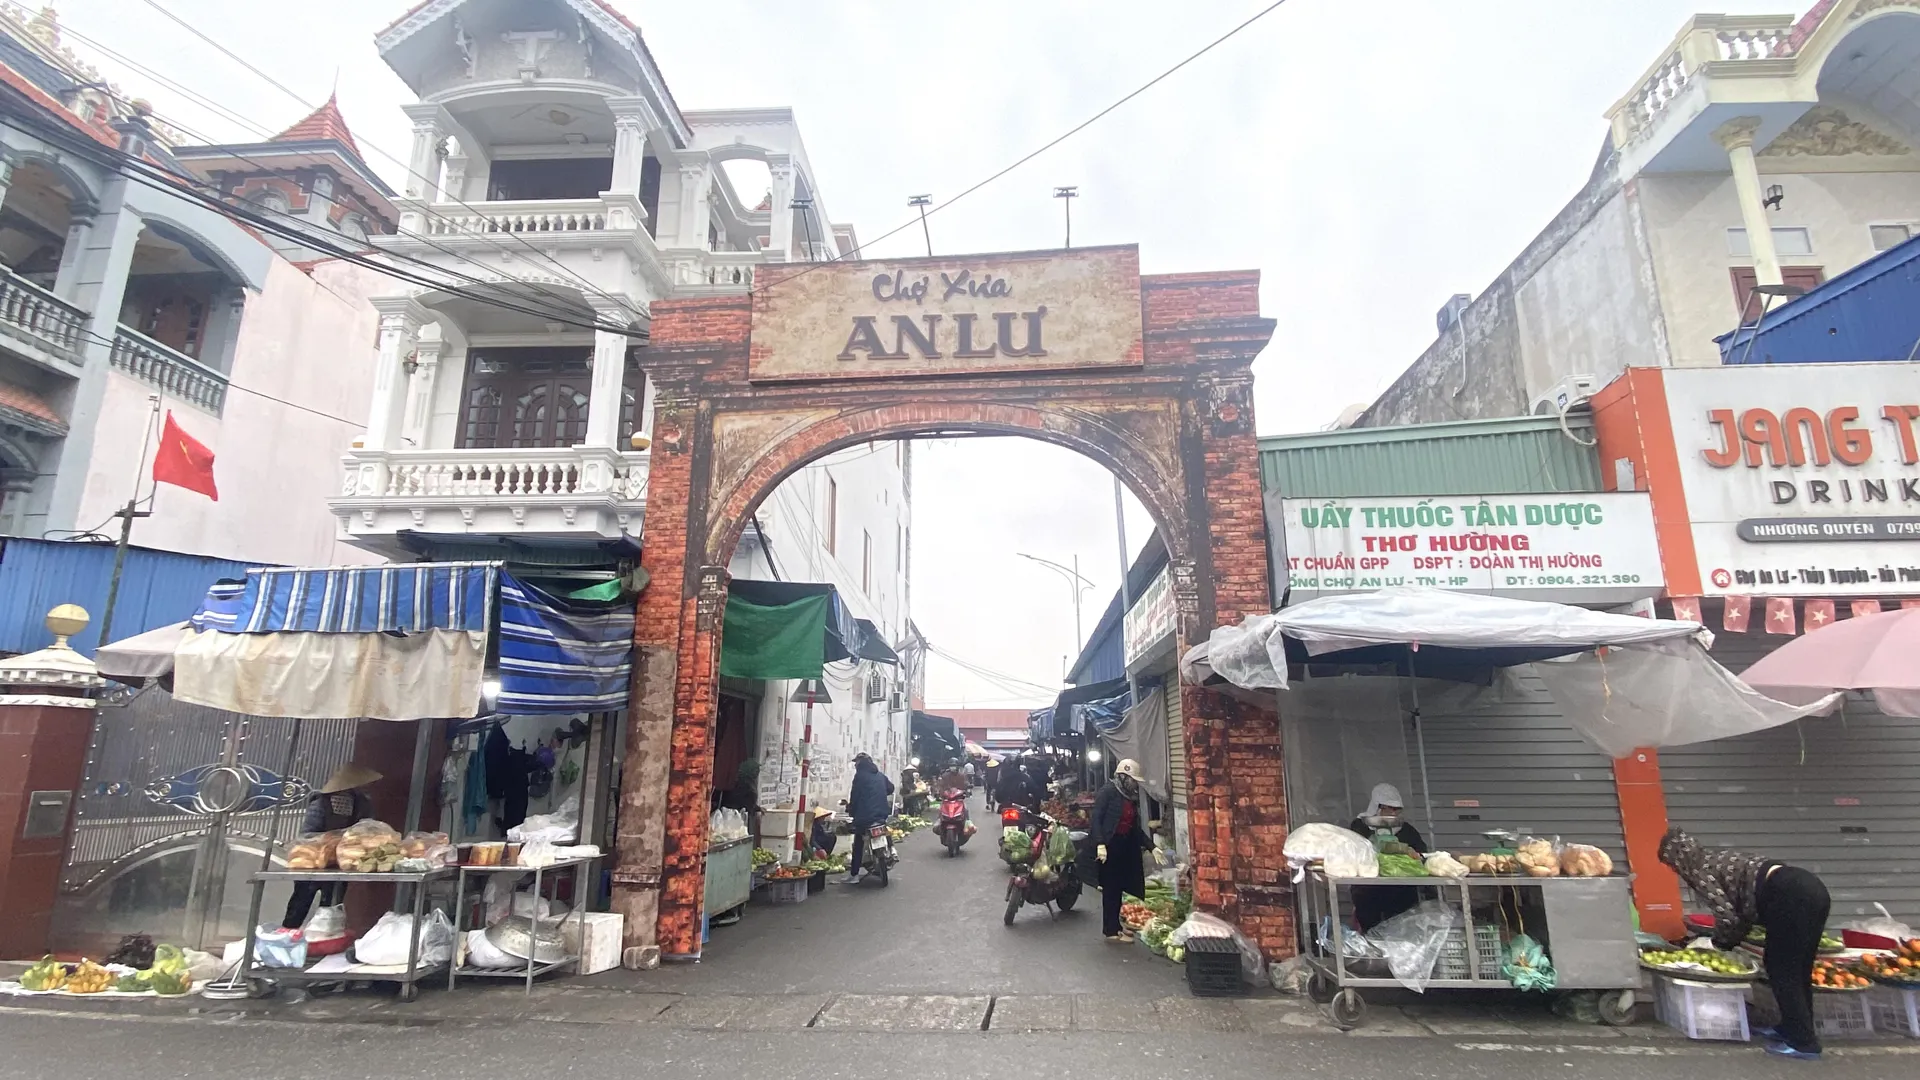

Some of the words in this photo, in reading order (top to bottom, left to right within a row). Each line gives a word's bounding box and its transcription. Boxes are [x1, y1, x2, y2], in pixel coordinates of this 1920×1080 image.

[872, 269, 929, 305] Chợ
[941, 269, 1012, 302] Xưa
[837, 314, 942, 361] AN
[953, 305, 1048, 358] LƯ
[1701, 406, 1873, 468] JANG
[1769, 477, 1920, 504] DRINK
[1361, 498, 1453, 528] THUỐC
[1461, 500, 1517, 526] TÂN
[1524, 502, 1603, 530] DƯỢC
[1362, 534, 1418, 552] THƠ
[1429, 531, 1530, 552] HƯỜNG
[1754, 523, 1819, 538] NHƯỢNG
[1304, 551, 1355, 570] CHUẨN
[1360, 557, 1389, 570] GPP
[1414, 556, 1453, 569] DSPT
[1470, 552, 1514, 569] ĐOÀN
[1519, 555, 1544, 571] THỊ
[1548, 552, 1602, 568] HƯỜNG
[1323, 576, 1354, 589] CHỢ
[1360, 577, 1381, 587] AN
[1386, 576, 1405, 586] LƯ
[1416, 576, 1437, 586] TN
[1450, 576, 1468, 586] HP
